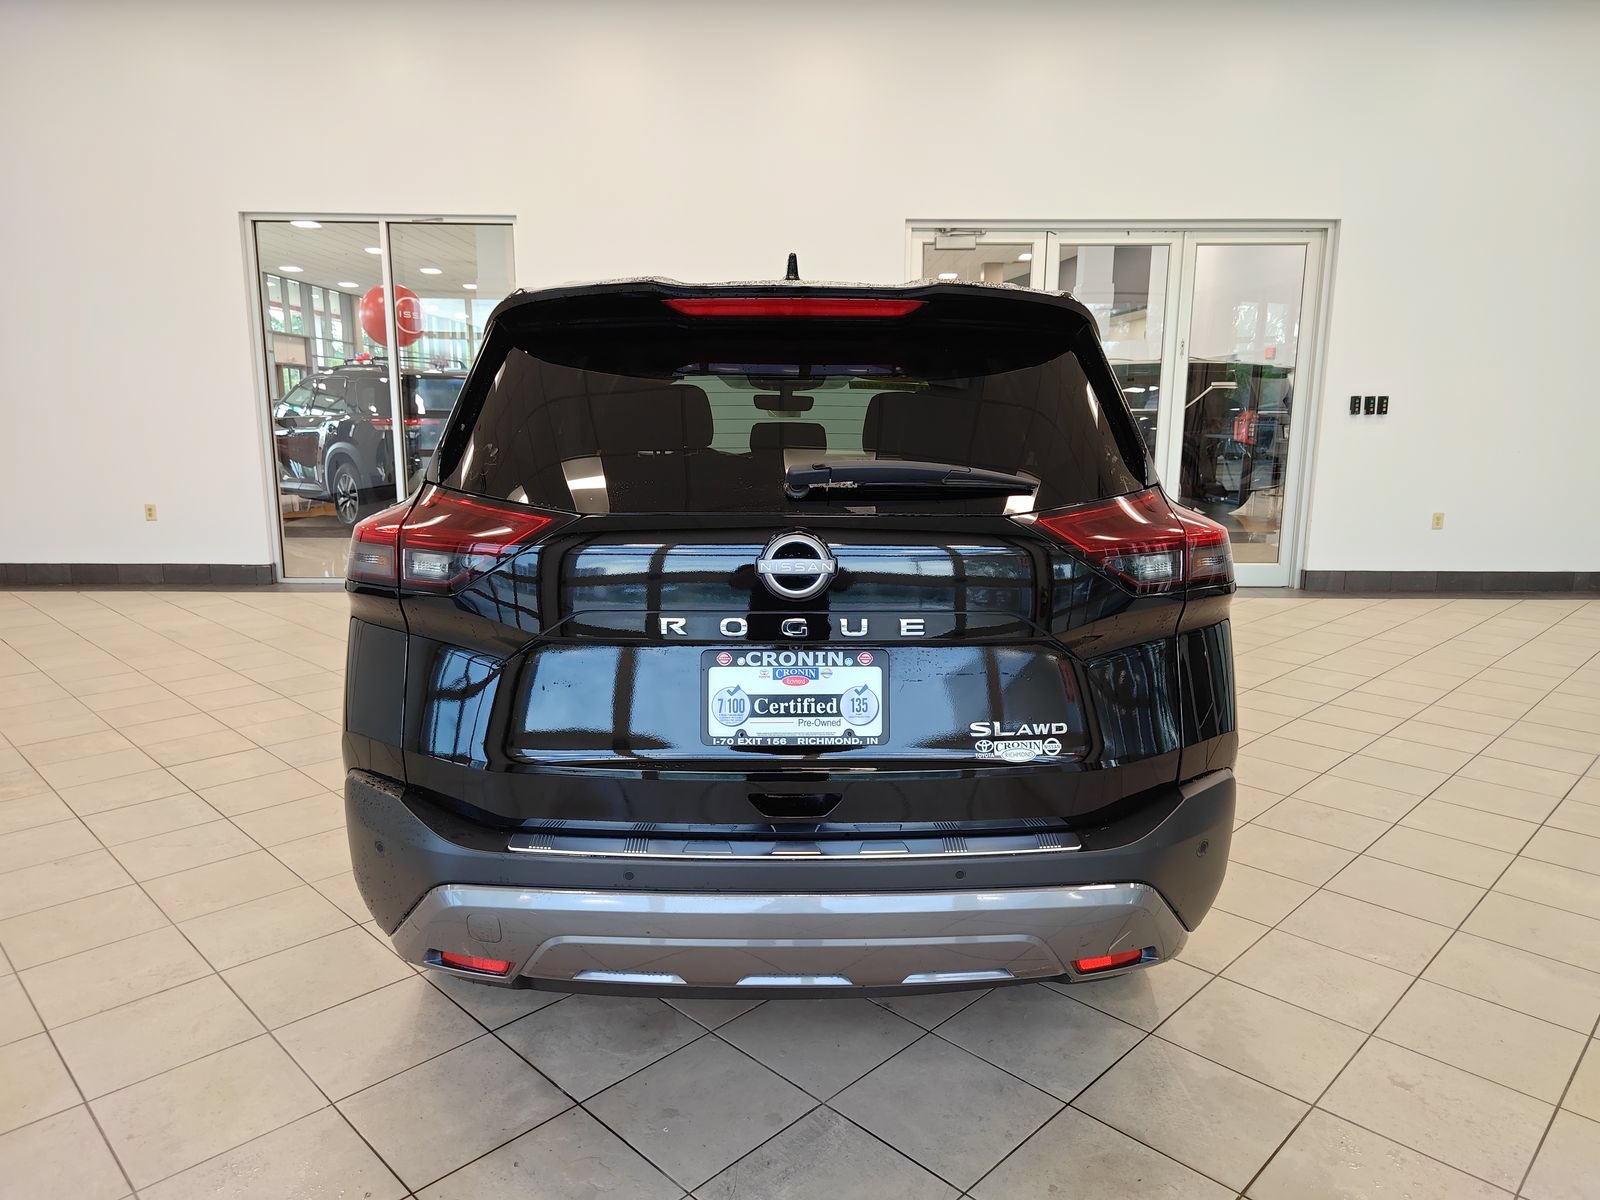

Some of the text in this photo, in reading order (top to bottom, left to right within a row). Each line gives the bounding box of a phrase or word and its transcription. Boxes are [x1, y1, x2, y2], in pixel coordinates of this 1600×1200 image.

[760, 562, 833, 572] NISSAN
[659, 617, 926, 637] ROGUE
[745, 651, 844, 666] CRONIN
[775, 668, 816, 679] CRONIN
[754, 697, 838, 714] Certified
[850, 697, 868, 713] 135
[798, 717, 841, 727] Pre-Owned
[766, 737, 787, 745] 156
[866, 737, 879, 745] IN
[995, 741, 1041, 752] CRONIN
